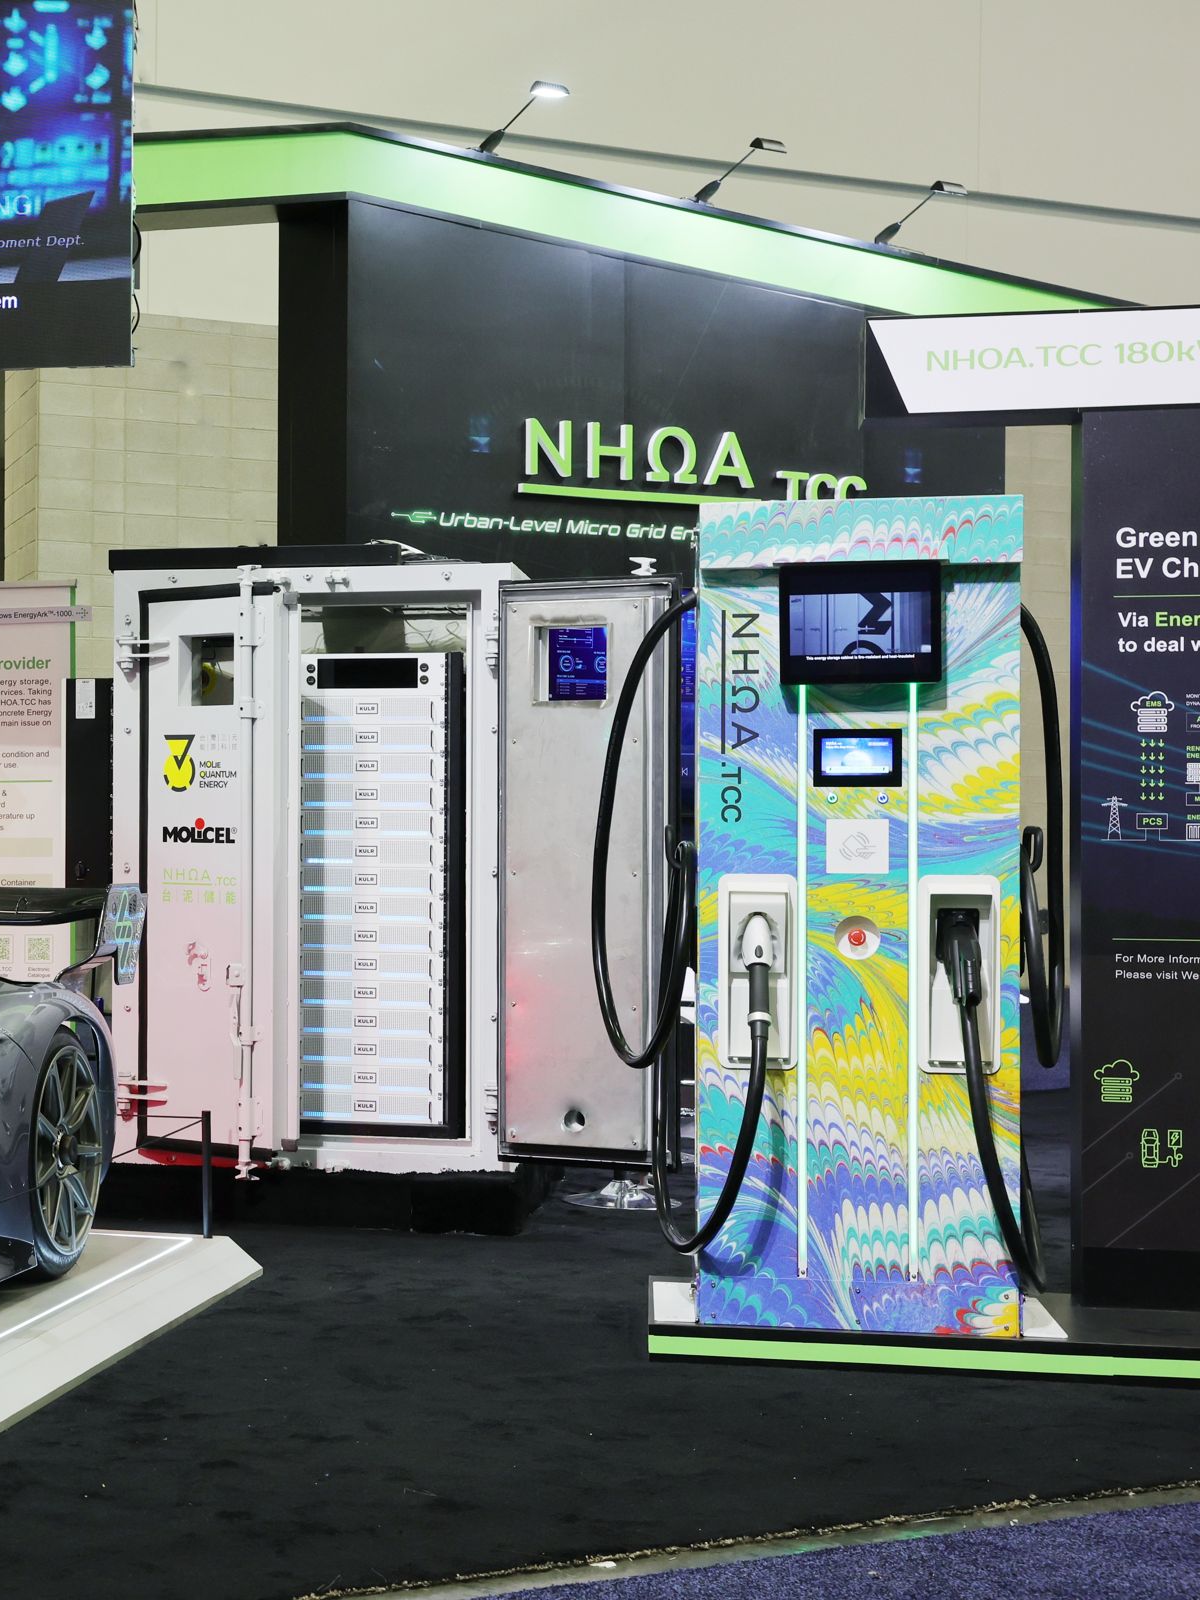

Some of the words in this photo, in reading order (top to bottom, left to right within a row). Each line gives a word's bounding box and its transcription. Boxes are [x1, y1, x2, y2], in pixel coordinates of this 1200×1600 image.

[46, 234, 84, 249] Dept.
[926, 343, 1102, 372] NHOA.TCC
[1113, 335, 1200, 364] 180k
[439, 512, 562, 533] Urban-Level
[566, 520, 621, 536] Micro
[626, 524, 666, 540] Grid
[671, 526, 697, 541] En
[1115, 525, 1197, 548] Green
[1116, 557, 1153, 578] EV
[1162, 556, 1198, 578] Ch
[13, 609, 73, 620] EnergyArk™-1000.
[1117, 611, 1148, 627] Via
[1117, 637, 1137, 652] to
[1143, 636, 1184, 652] deal
[19, 678, 51, 689] storage,
[26, 708, 52, 717] Energy
[199, 771, 237, 779] QUANTUM
[1142, 817, 1163, 825] PCS
[1115, 953, 1134, 962] For
[1137, 953, 1165, 963] More
[1115, 969, 1152, 979] Please
[1155, 970, 1178, 979] visit
